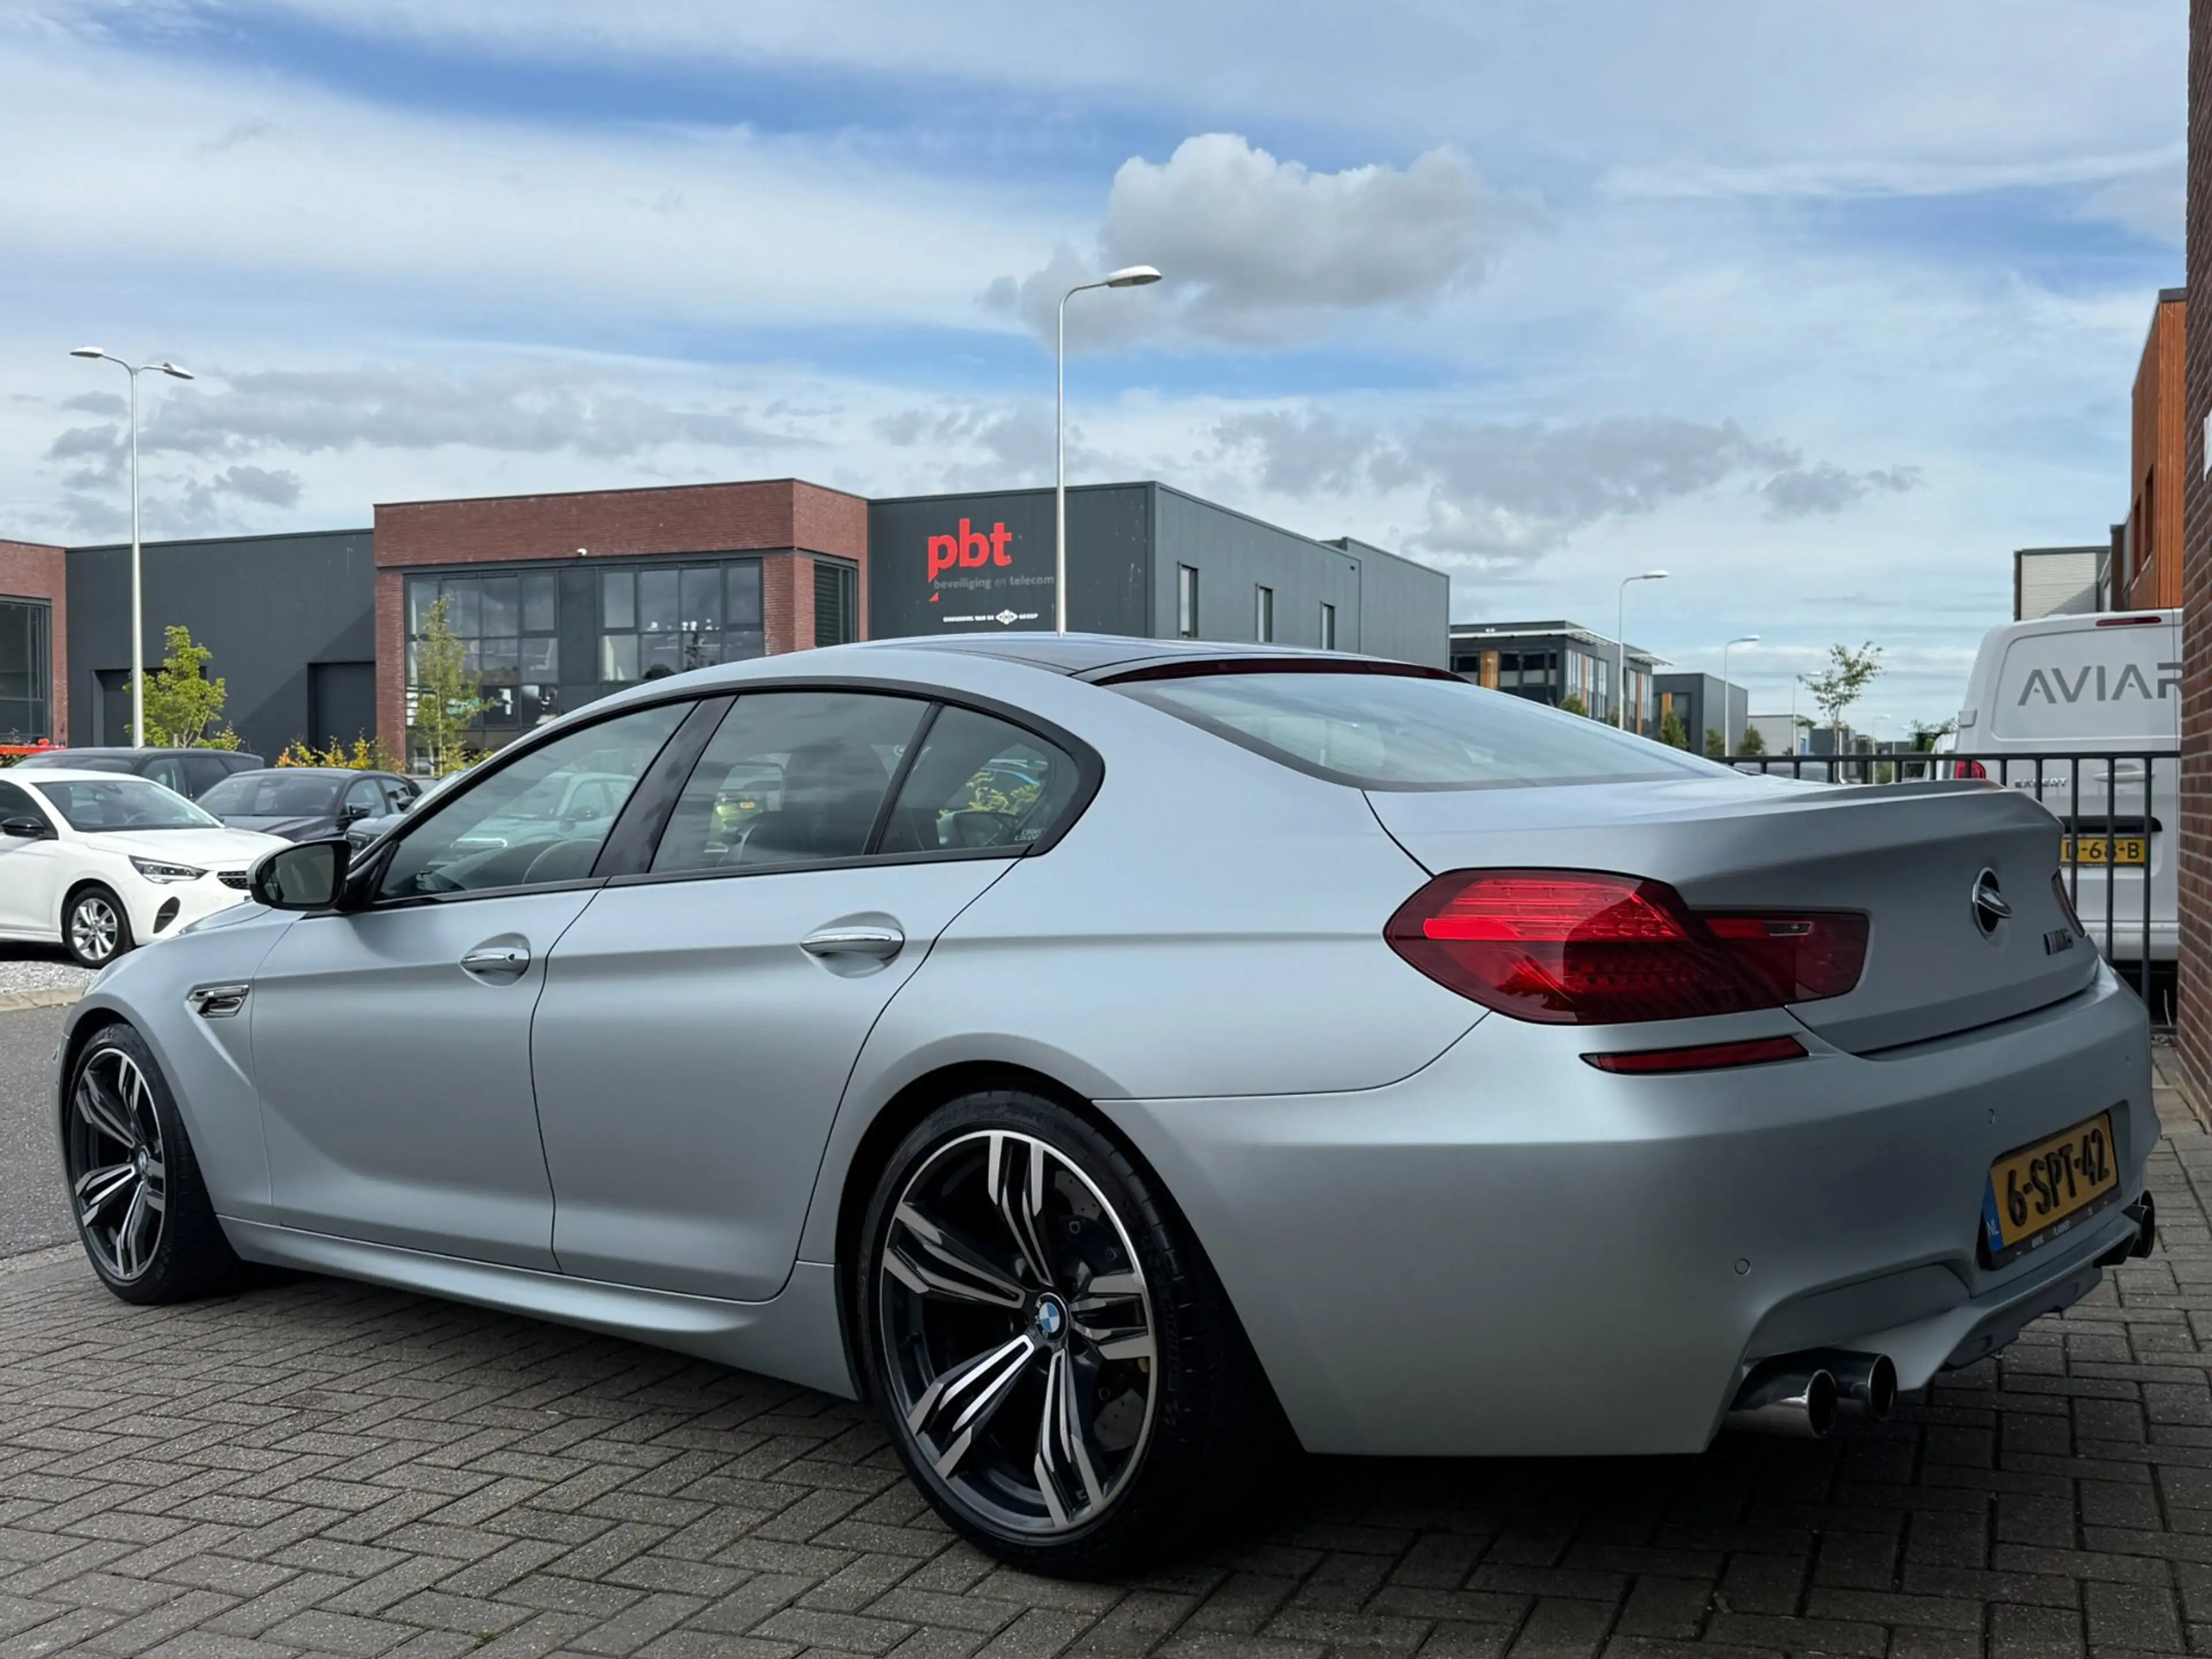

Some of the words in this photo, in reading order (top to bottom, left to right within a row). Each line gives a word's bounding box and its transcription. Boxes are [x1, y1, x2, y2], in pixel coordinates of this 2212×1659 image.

[928, 518, 1012, 601] pbt
[934, 578, 991, 590] beveiliging
[1010, 575, 1055, 586] telecom
[2008, 1129, 2109, 1227] 6-SPT-42
[1986, 1222, 2000, 1236] NL
